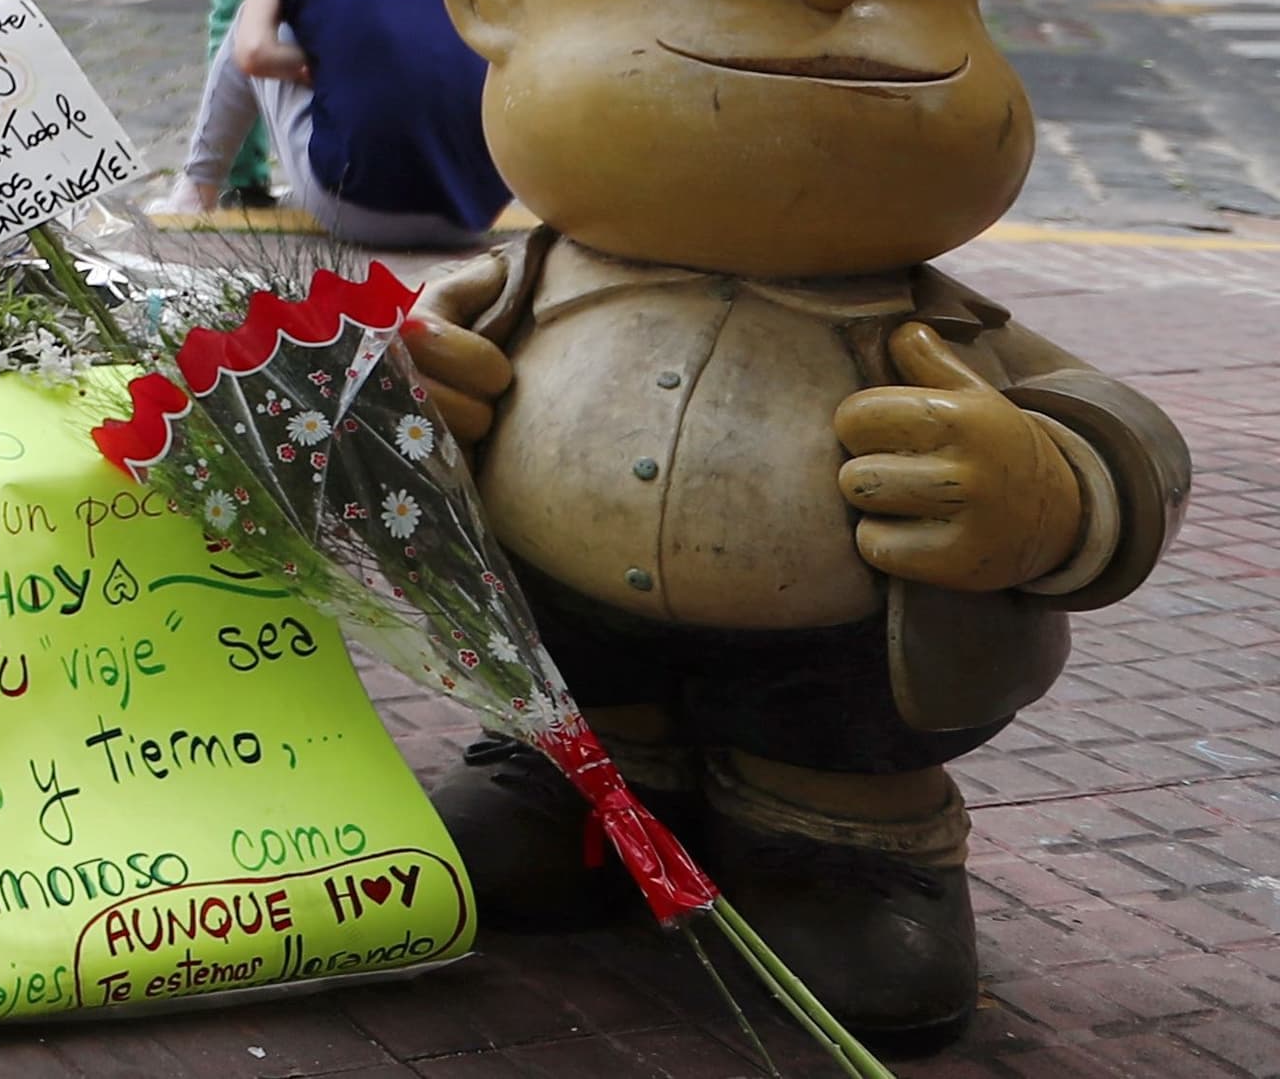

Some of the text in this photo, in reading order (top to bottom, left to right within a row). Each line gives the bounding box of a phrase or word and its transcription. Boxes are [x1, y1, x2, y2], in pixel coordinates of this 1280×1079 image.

[2, 499, 57, 535] un
[76, 489, 163, 559] poc
[29, 757, 81, 846] y
[231, 822, 367, 872] como
[104, 888, 293, 958] AUNQUE
